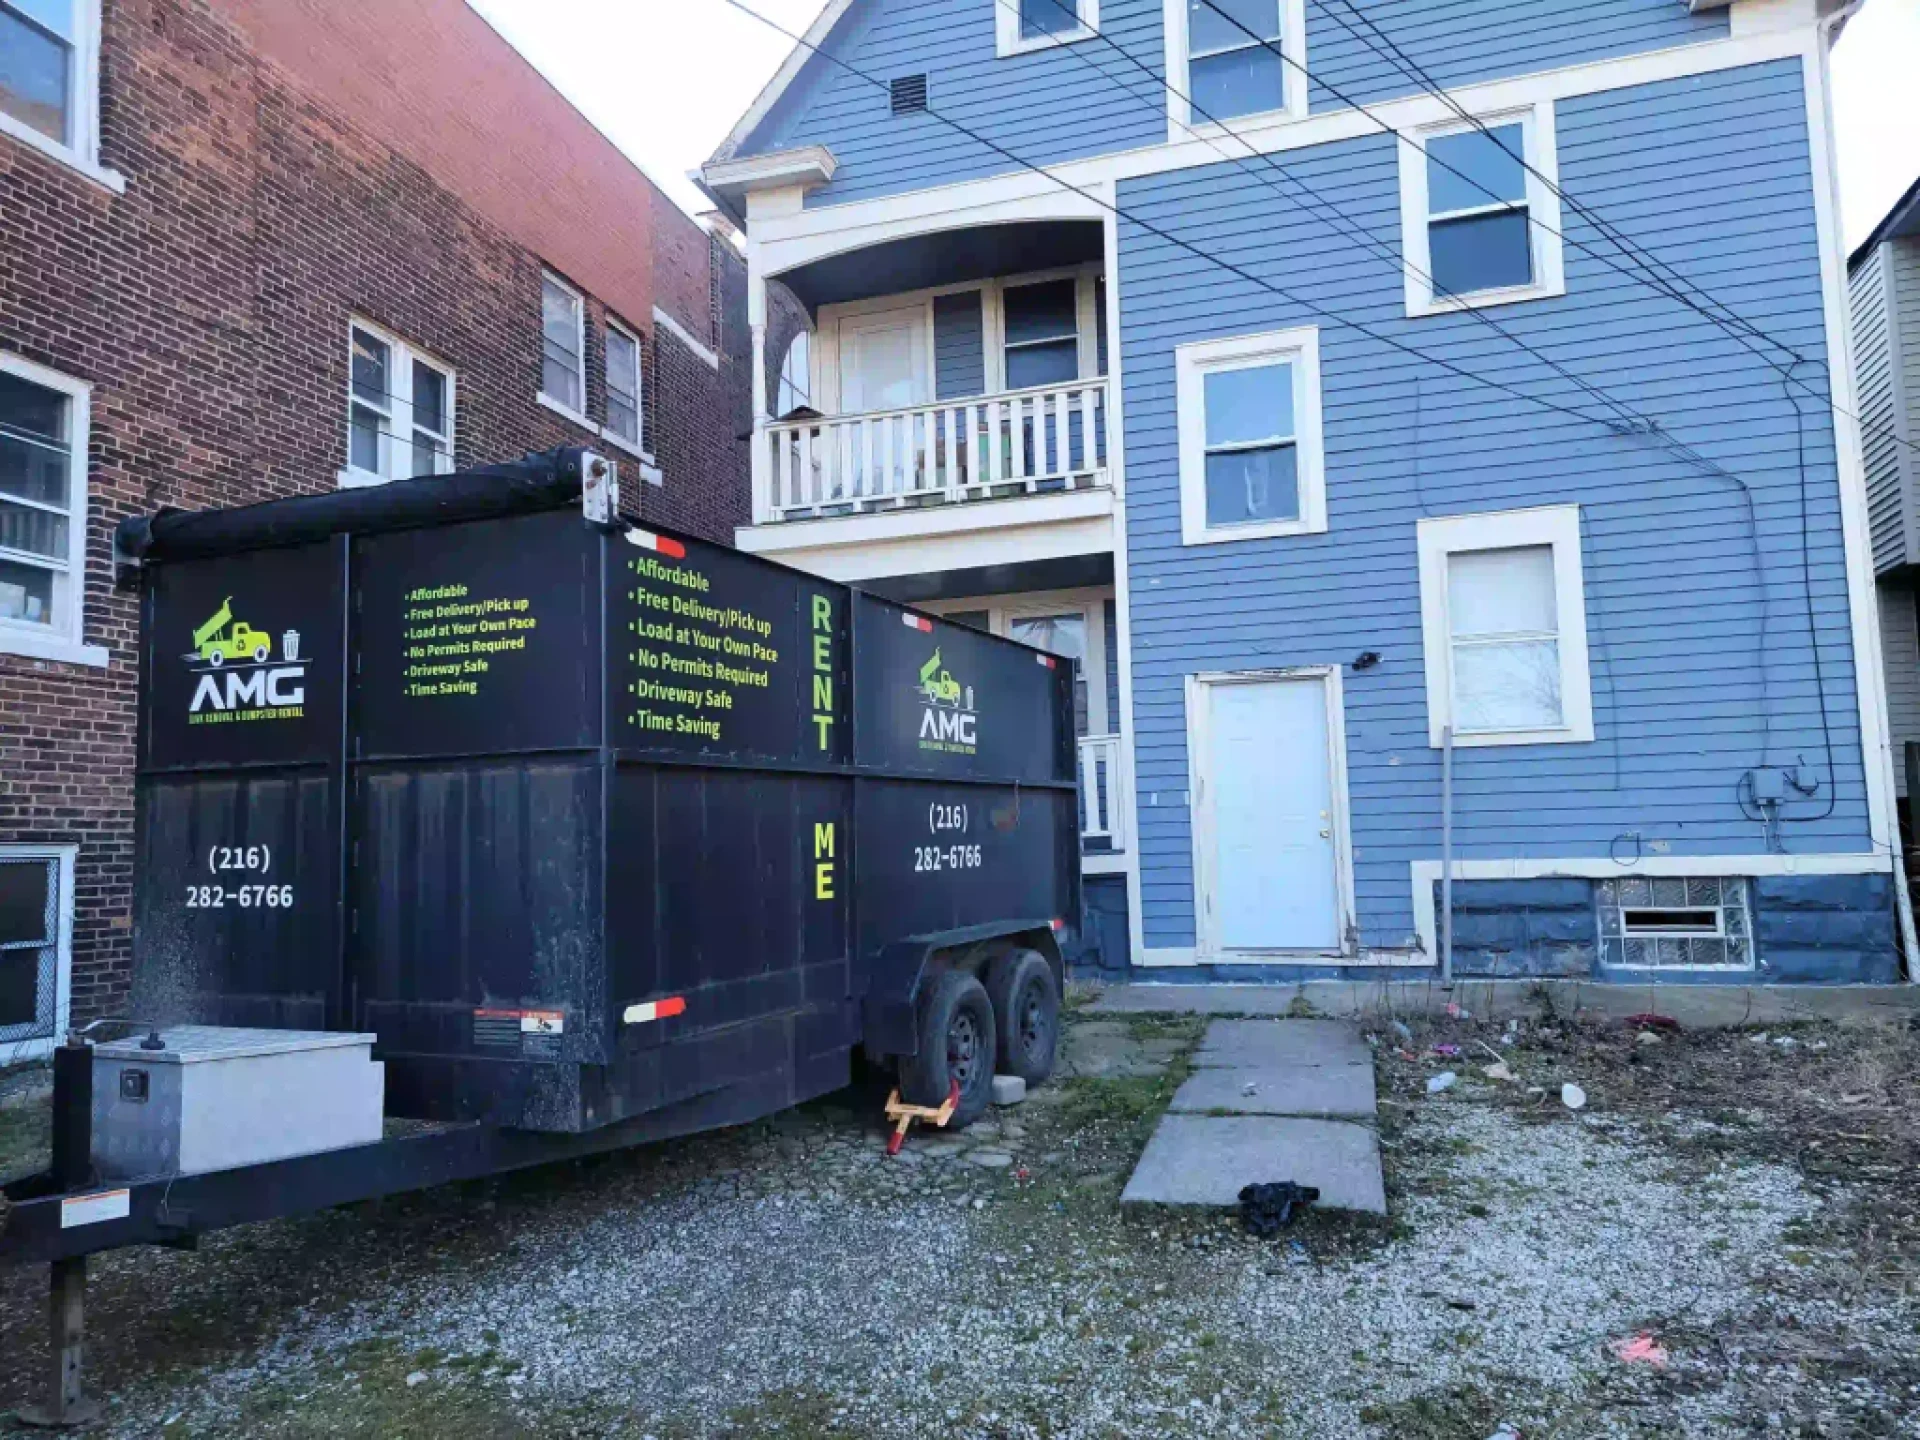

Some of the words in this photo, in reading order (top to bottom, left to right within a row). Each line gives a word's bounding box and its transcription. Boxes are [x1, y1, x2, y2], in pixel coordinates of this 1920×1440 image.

[636, 556, 710, 592] Affordable
[410, 583, 468, 602] Affordable
[410, 609, 434, 620] Free
[513, 599, 529, 611] up
[637, 587, 670, 610] Free
[757, 620, 772, 638] up
[410, 624, 436, 639] Load
[438, 625, 450, 636] at
[452, 622, 477, 634] Your
[480, 620, 506, 632] Own
[508, 618, 536, 630] Pace
[638, 617, 672, 641] Load
[676, 628, 690, 645] at
[692, 629, 721, 650] Your
[724, 636, 750, 656] Own
[753, 643, 778, 662] Pace
[410, 646, 424, 658] No
[427, 641, 470, 656] Permits
[472, 635, 525, 653] Required
[410, 664, 461, 677] Driveway
[463, 658, 488, 672] Safe
[638, 648, 658, 668] No
[661, 652, 713, 678] Permits
[716, 662, 768, 687] Required
[811, 594, 834, 750] RENT
[189, 667, 304, 712] AMG
[410, 682, 437, 696] Time
[440, 679, 477, 694] Saving
[638, 678, 703, 709] Driveway
[705, 689, 732, 709] Safe
[636, 710, 673, 731] Time
[676, 714, 720, 741] Saving
[919, 708, 976, 744] AMG
[929, 802, 968, 834] (216)
[209, 844, 271, 874] (216)
[814, 822, 835, 899] ME
[914, 844, 982, 872] 282-6766
[186, 884, 294, 908] 282-6766
